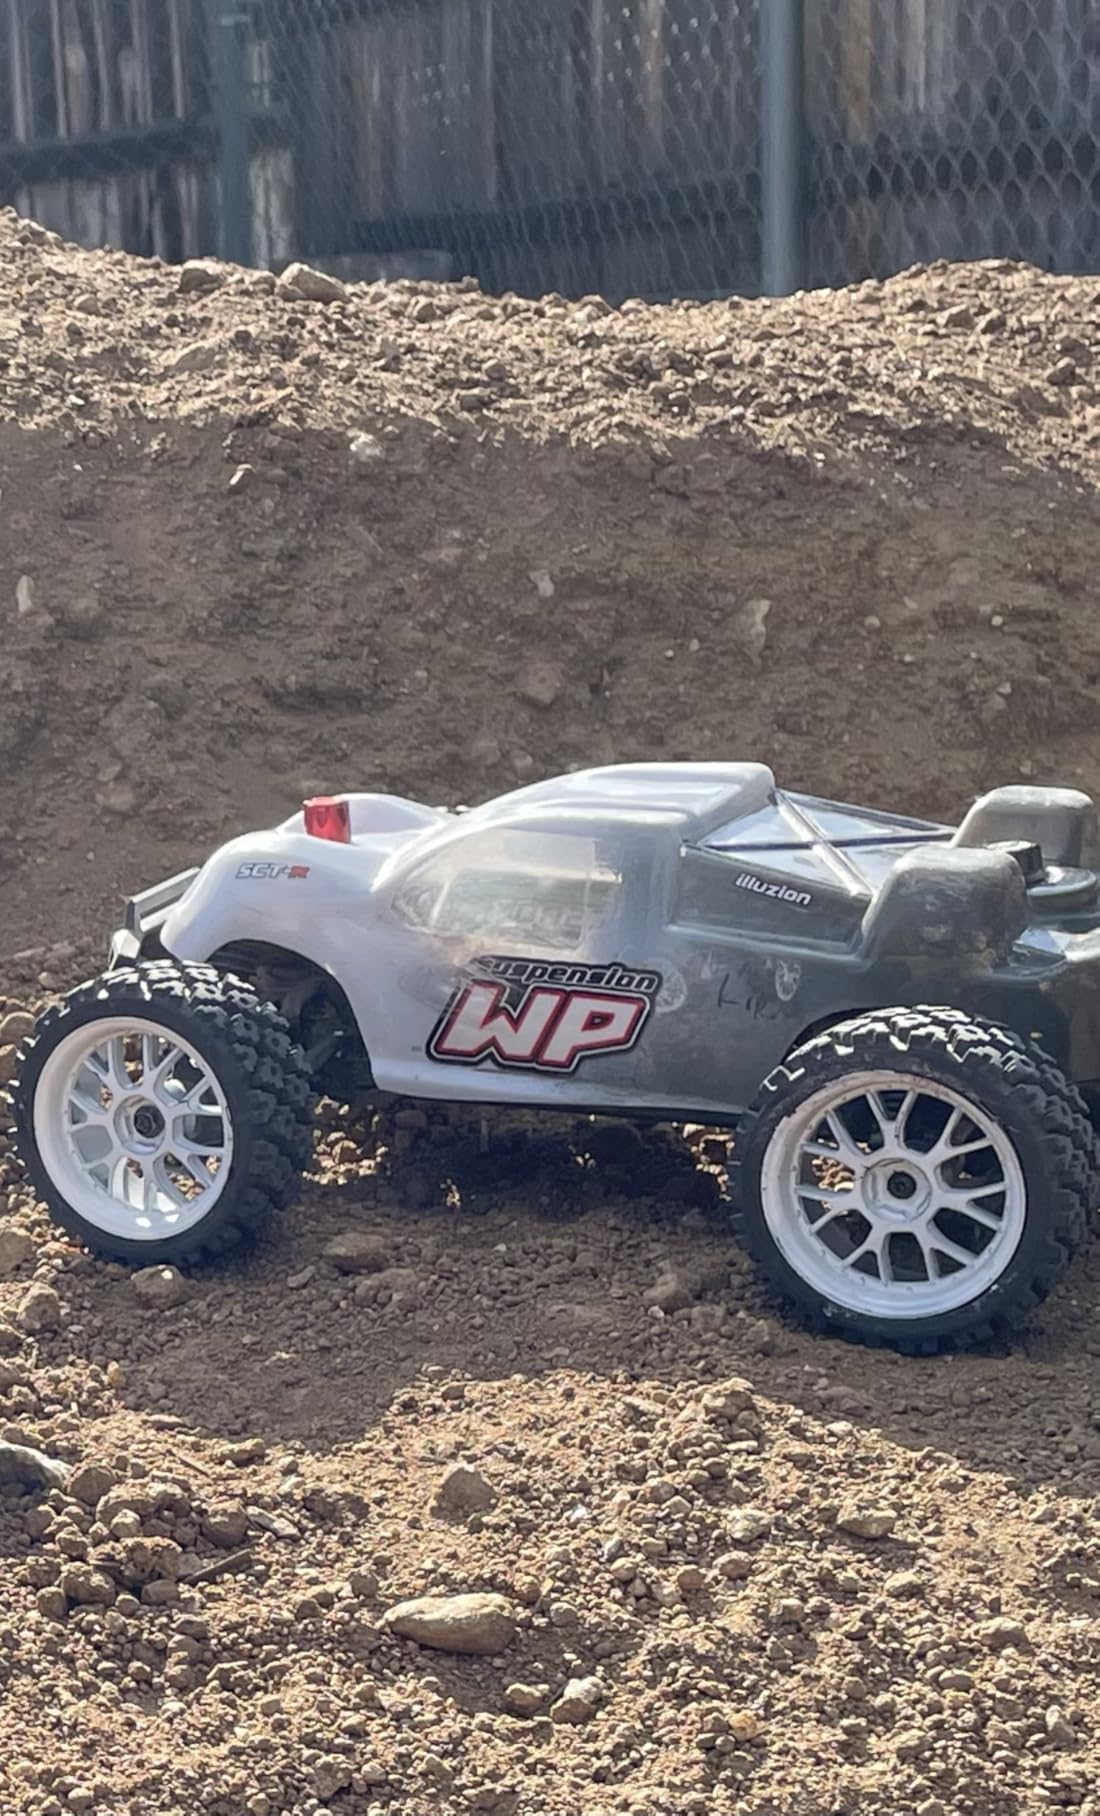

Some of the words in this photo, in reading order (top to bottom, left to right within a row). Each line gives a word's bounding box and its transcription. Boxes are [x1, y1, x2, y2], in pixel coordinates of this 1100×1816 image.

[735, 873, 812, 905] illuzion
[481, 956, 658, 991] uspension
[433, 979, 648, 1067] WP
